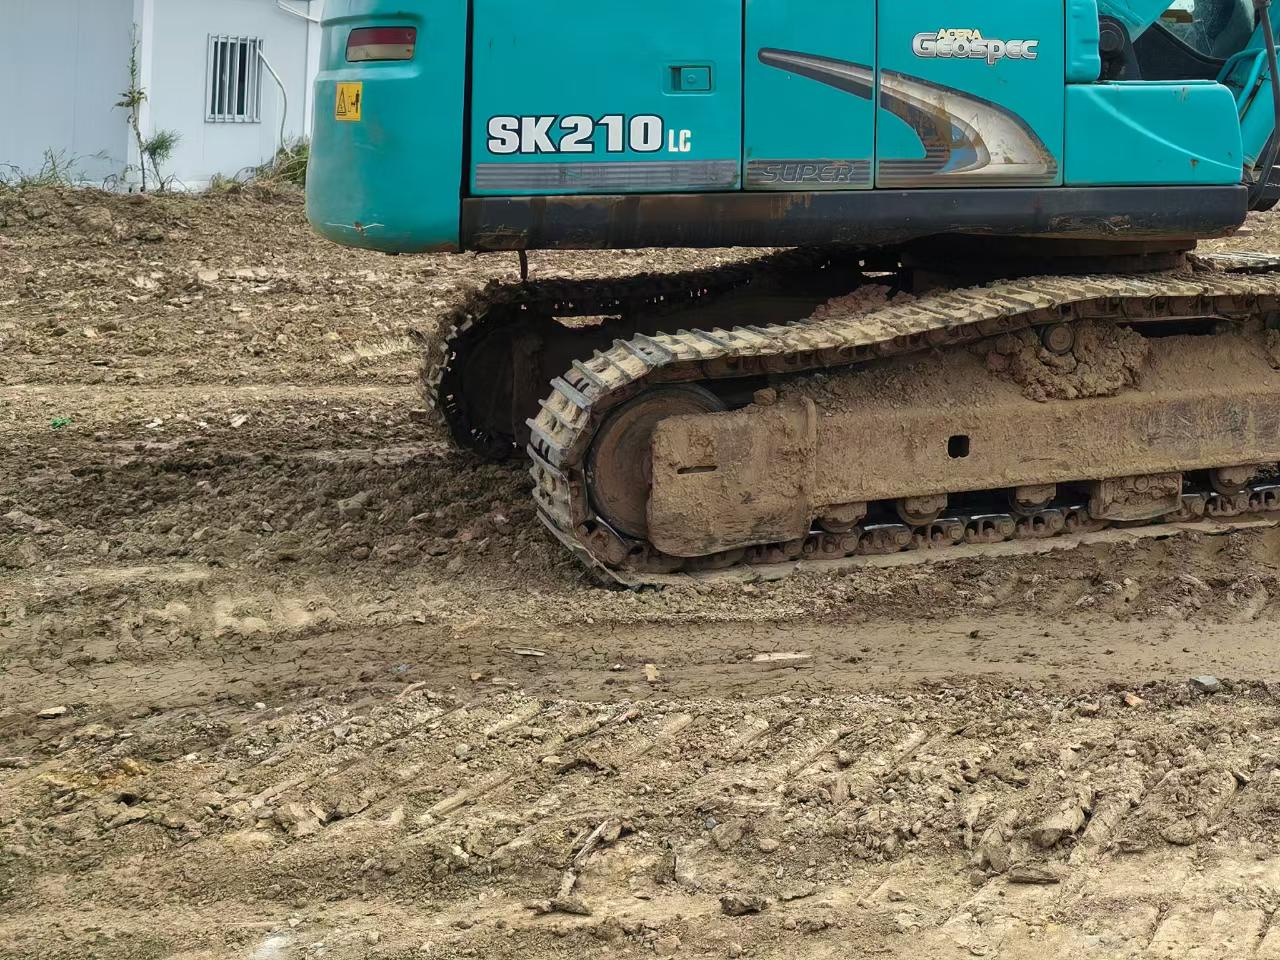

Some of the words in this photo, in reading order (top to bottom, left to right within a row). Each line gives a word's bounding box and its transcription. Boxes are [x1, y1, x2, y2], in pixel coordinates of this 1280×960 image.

[487, 114, 663, 154] SK210
[668, 129, 692, 152] LC
[760, 163, 854, 183] SUPER
